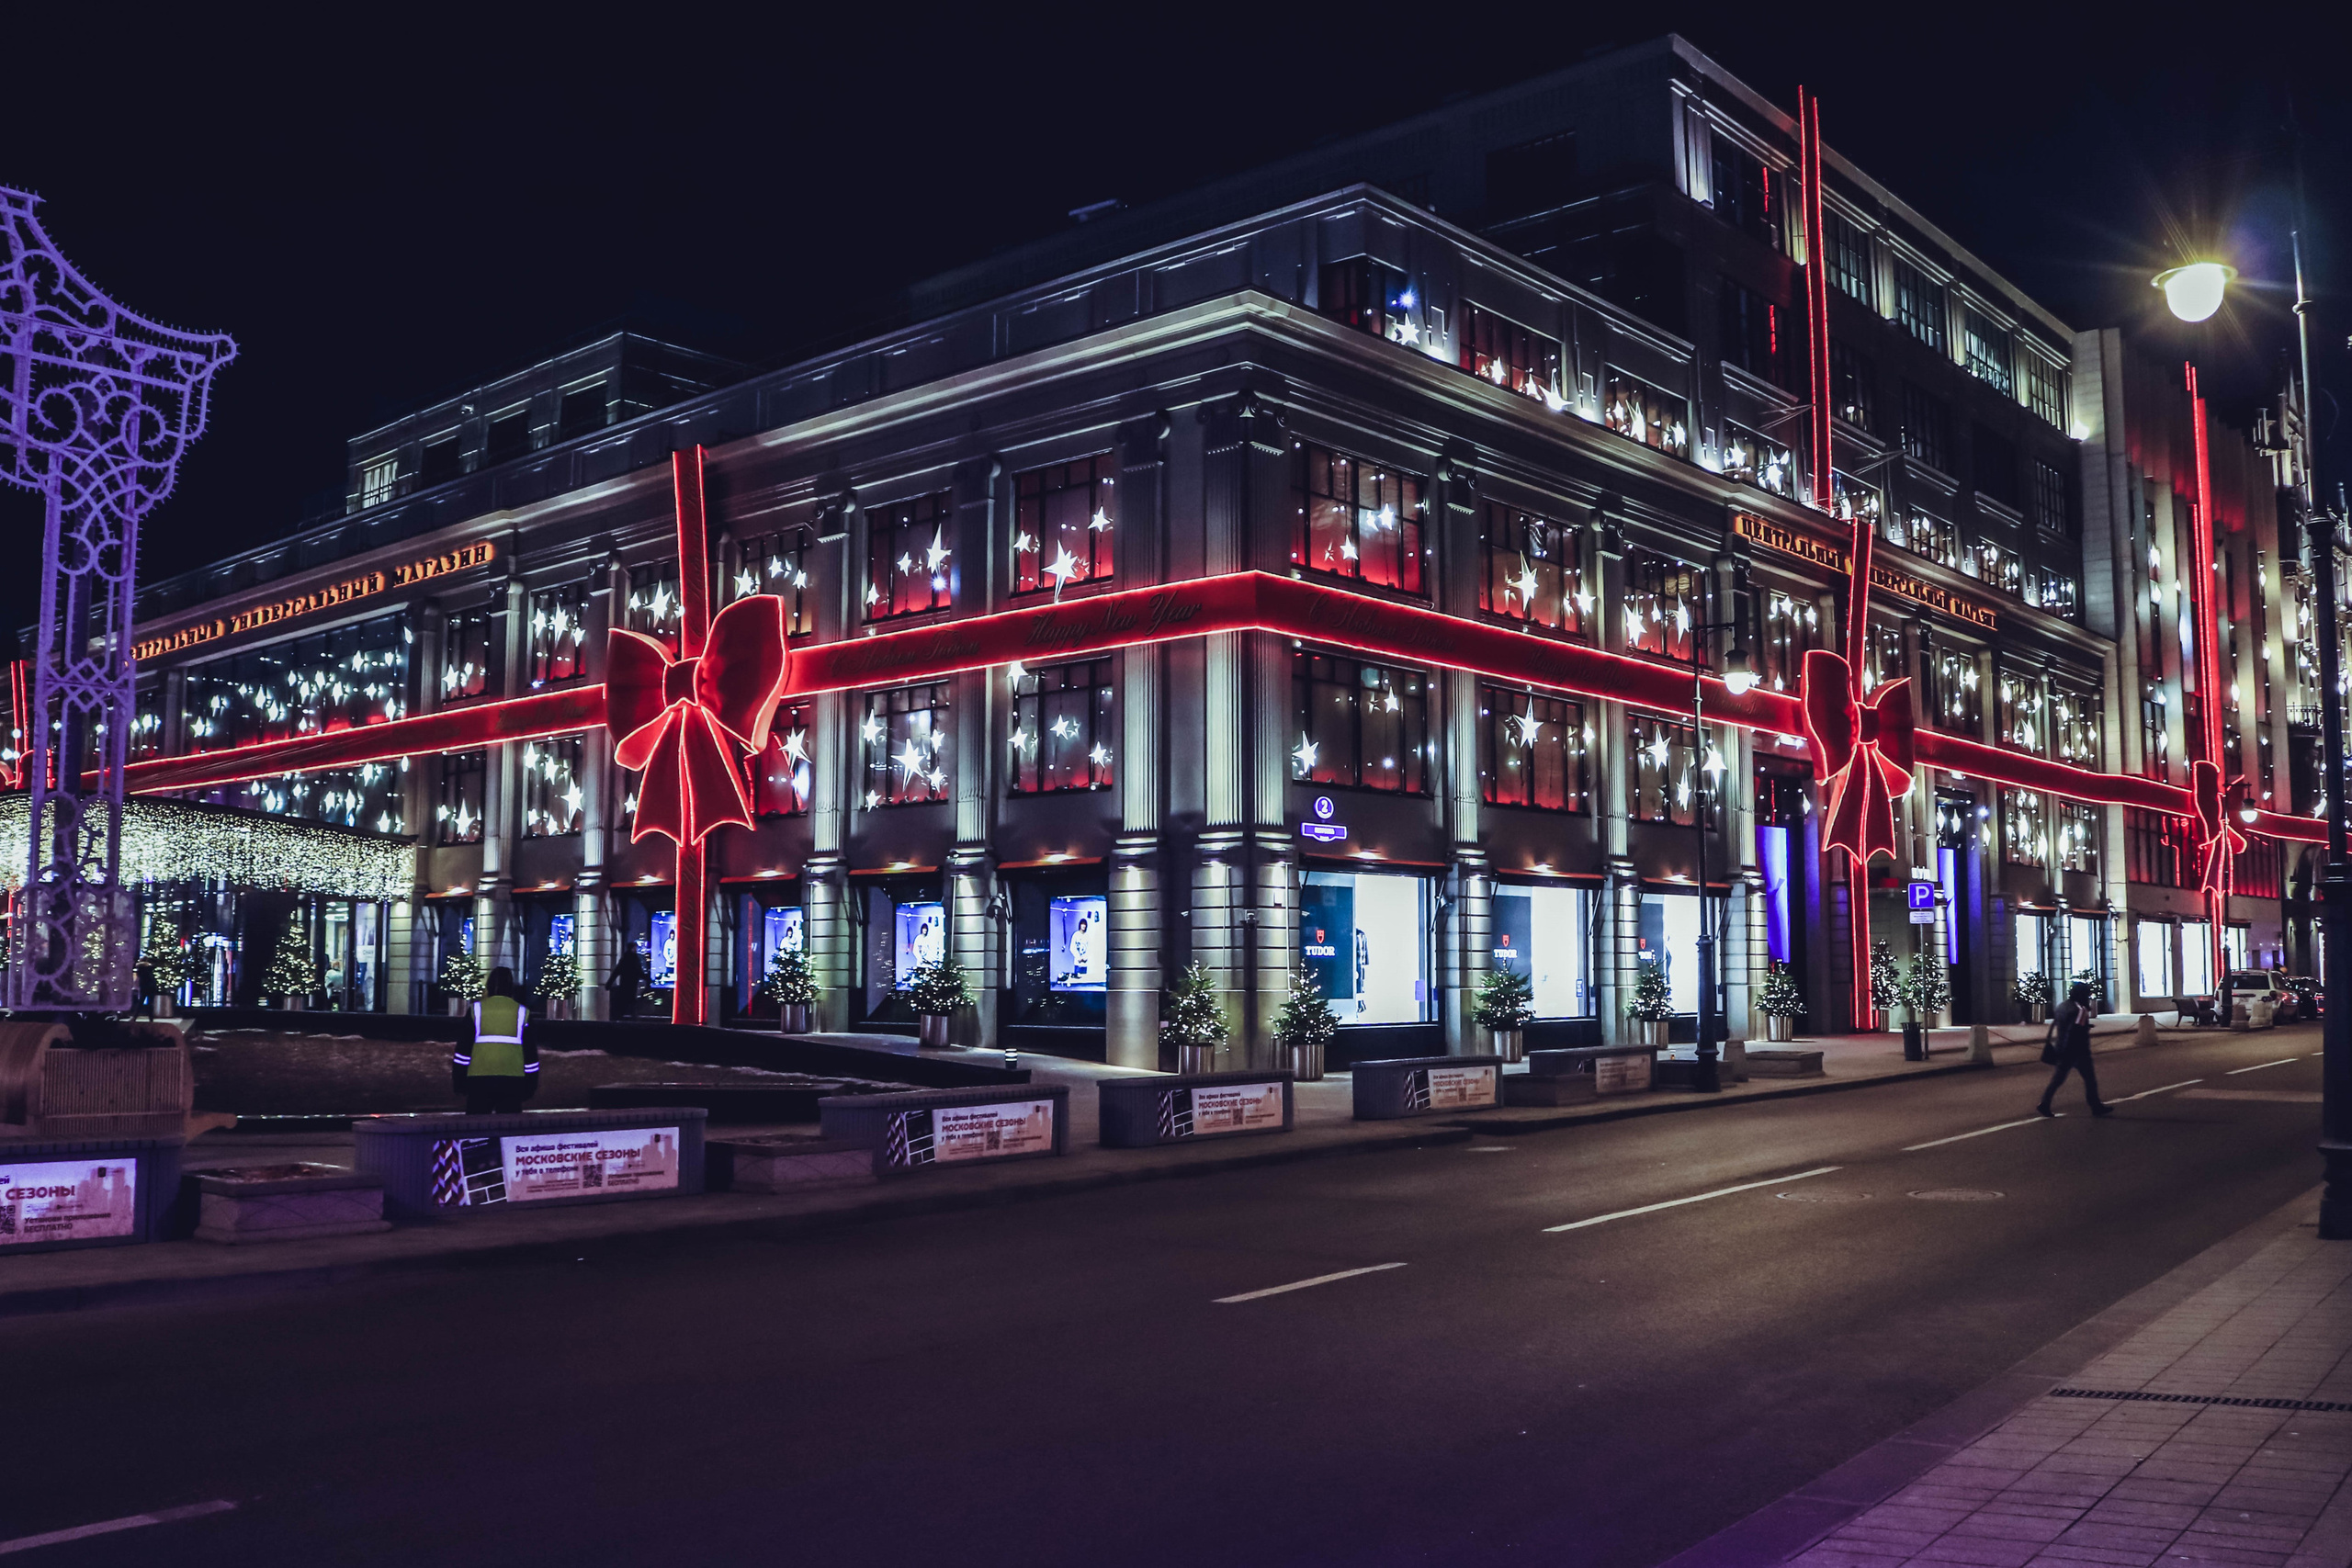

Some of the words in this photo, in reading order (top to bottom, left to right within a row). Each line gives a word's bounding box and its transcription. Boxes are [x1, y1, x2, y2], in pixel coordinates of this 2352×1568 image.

[230, 574, 379, 633] УНИВЕРСАЛЬНЫЙ
[392, 546, 489, 588] МАГАЗИН
[1023, 612, 1091, 651] Happy
[1091, 599, 1138, 636] New
[1145, 590, 1204, 636] Year
[1321, 799, 1329, 813] 2
[1916, 886, 1930, 906] P
[1305, 945, 1336, 956] TUDOR
[1494, 949, 1518, 958] TUDOR
[942, 1120, 993, 1133] МОСКОВСКИЕ
[995, 1117, 1026, 1128] СЕЗОНЫ
[515, 1145, 529, 1153] Вся
[531, 1144, 555, 1153] афиша
[557, 1140, 599, 1152] фестивалей
[515, 1151, 593, 1167] МОСКОВСКИЕ
[595, 1148, 640, 1160] СЕЗОНЫ
[522, 1168, 537, 1176] тебя
[545, 1165, 579, 1174] телефоне
[5, 1185, 76, 1201] СЕЗОНЫ
[24, 1223, 74, 1234] БЕСПЛАТНО
